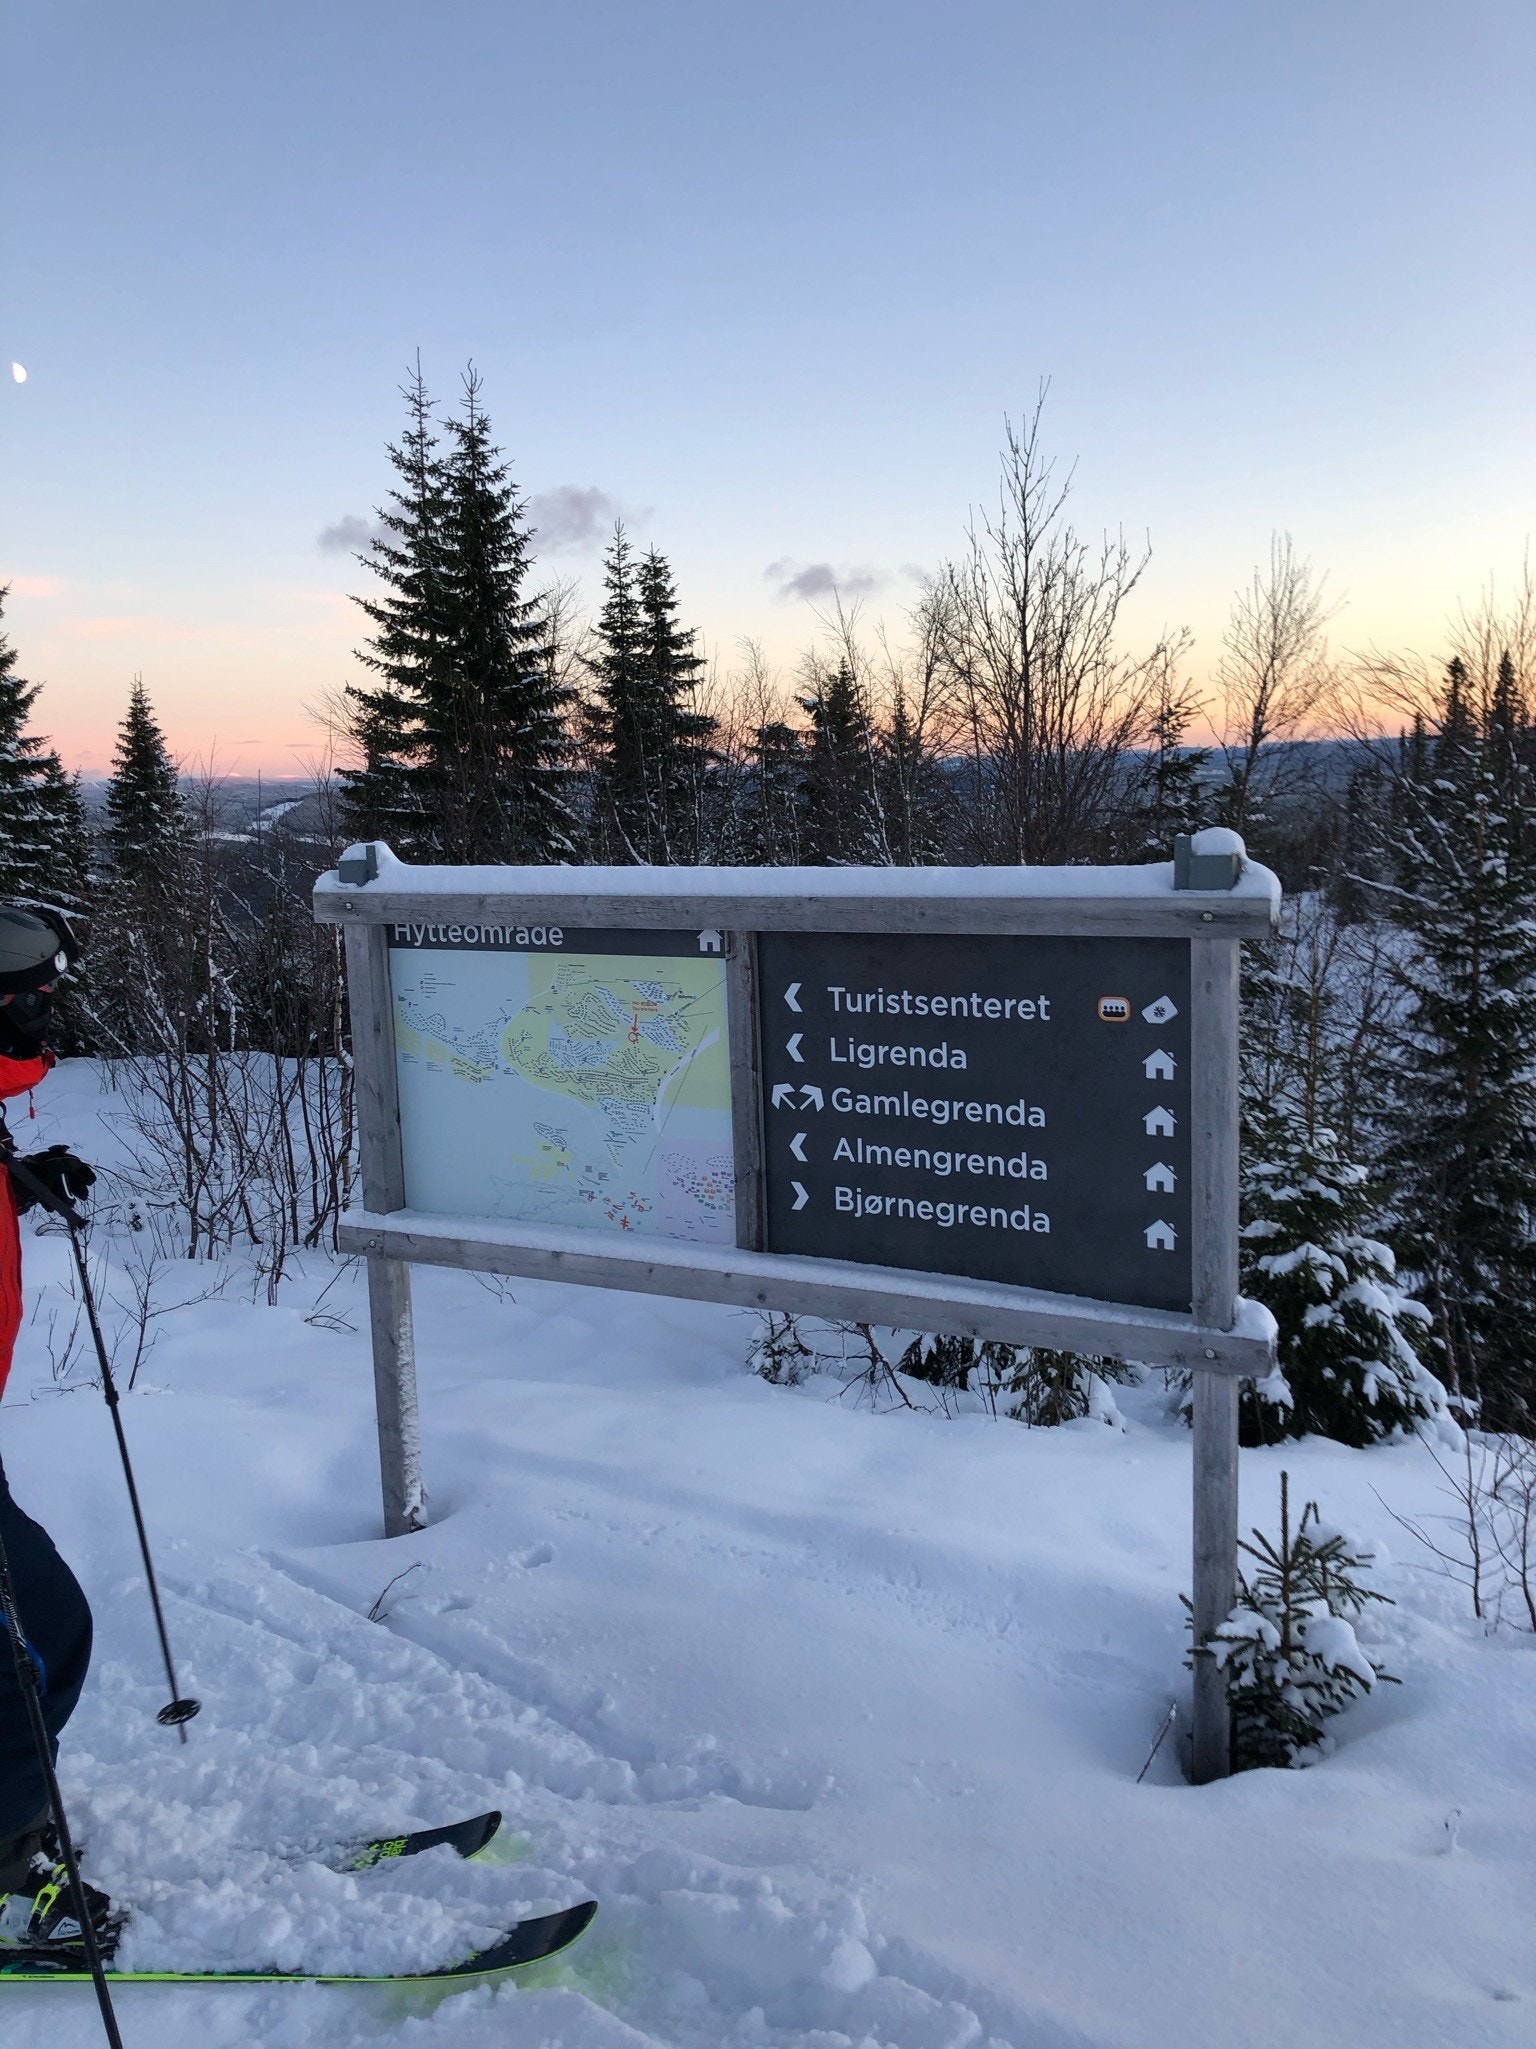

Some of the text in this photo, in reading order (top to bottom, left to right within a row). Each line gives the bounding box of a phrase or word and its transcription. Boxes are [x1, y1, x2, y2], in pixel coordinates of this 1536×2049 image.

[827, 986, 1051, 1021] Turistsenteret
[830, 1037, 968, 1070] Ligrenda
[831, 1087, 1046, 1128] Gamlegrenda
[833, 1137, 1048, 1181] Almengrenda
[835, 1186, 1051, 1234] Bjørnegrenda
